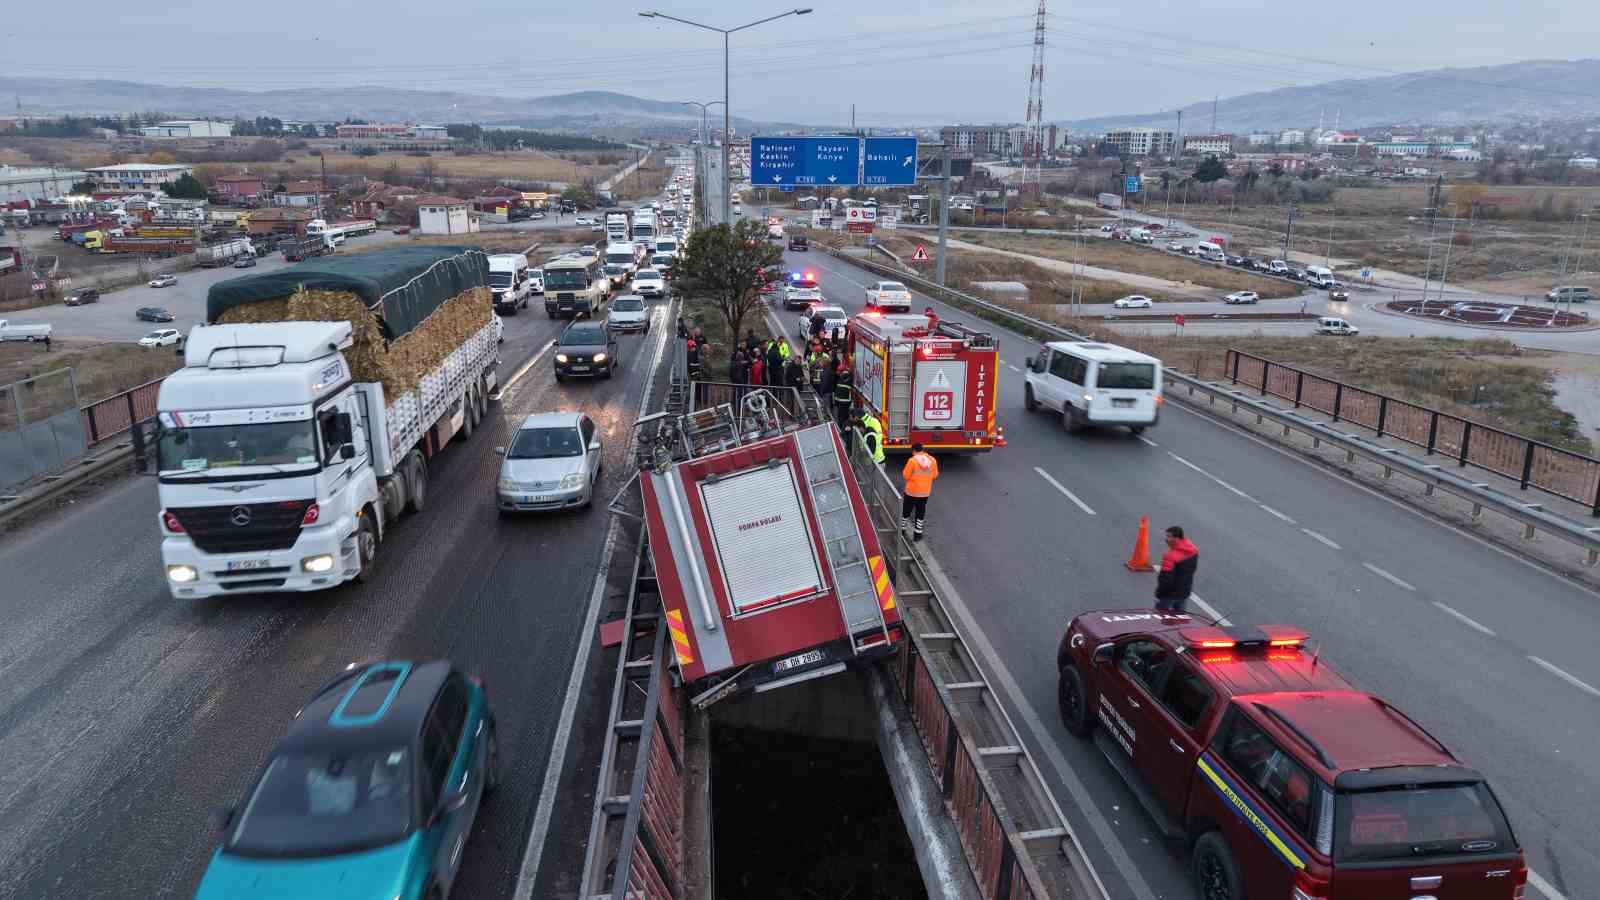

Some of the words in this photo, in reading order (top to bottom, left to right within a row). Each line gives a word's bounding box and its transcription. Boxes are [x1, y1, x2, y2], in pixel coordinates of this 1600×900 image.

[760, 144, 795, 152] Rafineri
[817, 144, 849, 153] Kayseri
[928, 394, 948, 409] 112
